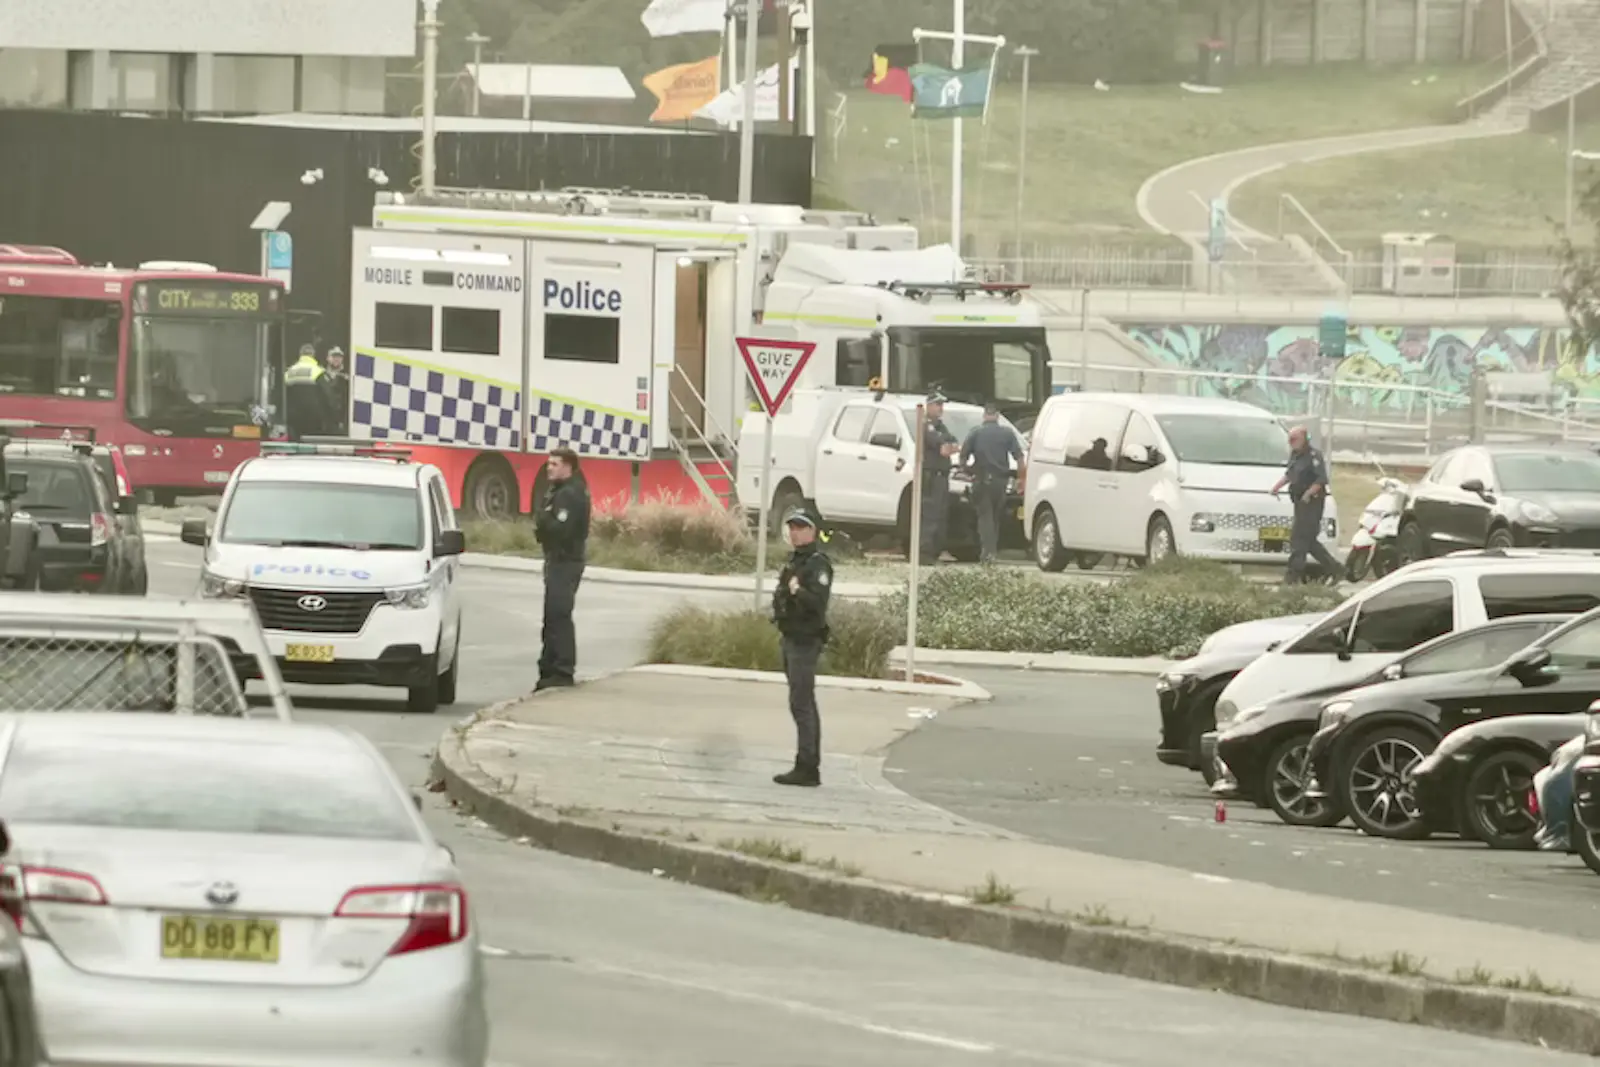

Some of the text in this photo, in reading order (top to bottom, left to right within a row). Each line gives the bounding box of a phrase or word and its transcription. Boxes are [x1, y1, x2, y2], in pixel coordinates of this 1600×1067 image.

[365, 267, 522, 292] MOBILE COMMAND
[158, 289, 191, 308] CITY
[231, 291, 259, 310] 333
[543, 278, 621, 312] Police
[757, 352, 793, 366] GIVE
[761, 368, 786, 379] WAY
[253, 564, 371, 580] Police
[205, 923, 236, 950] 88
[244, 924, 276, 952] FY
